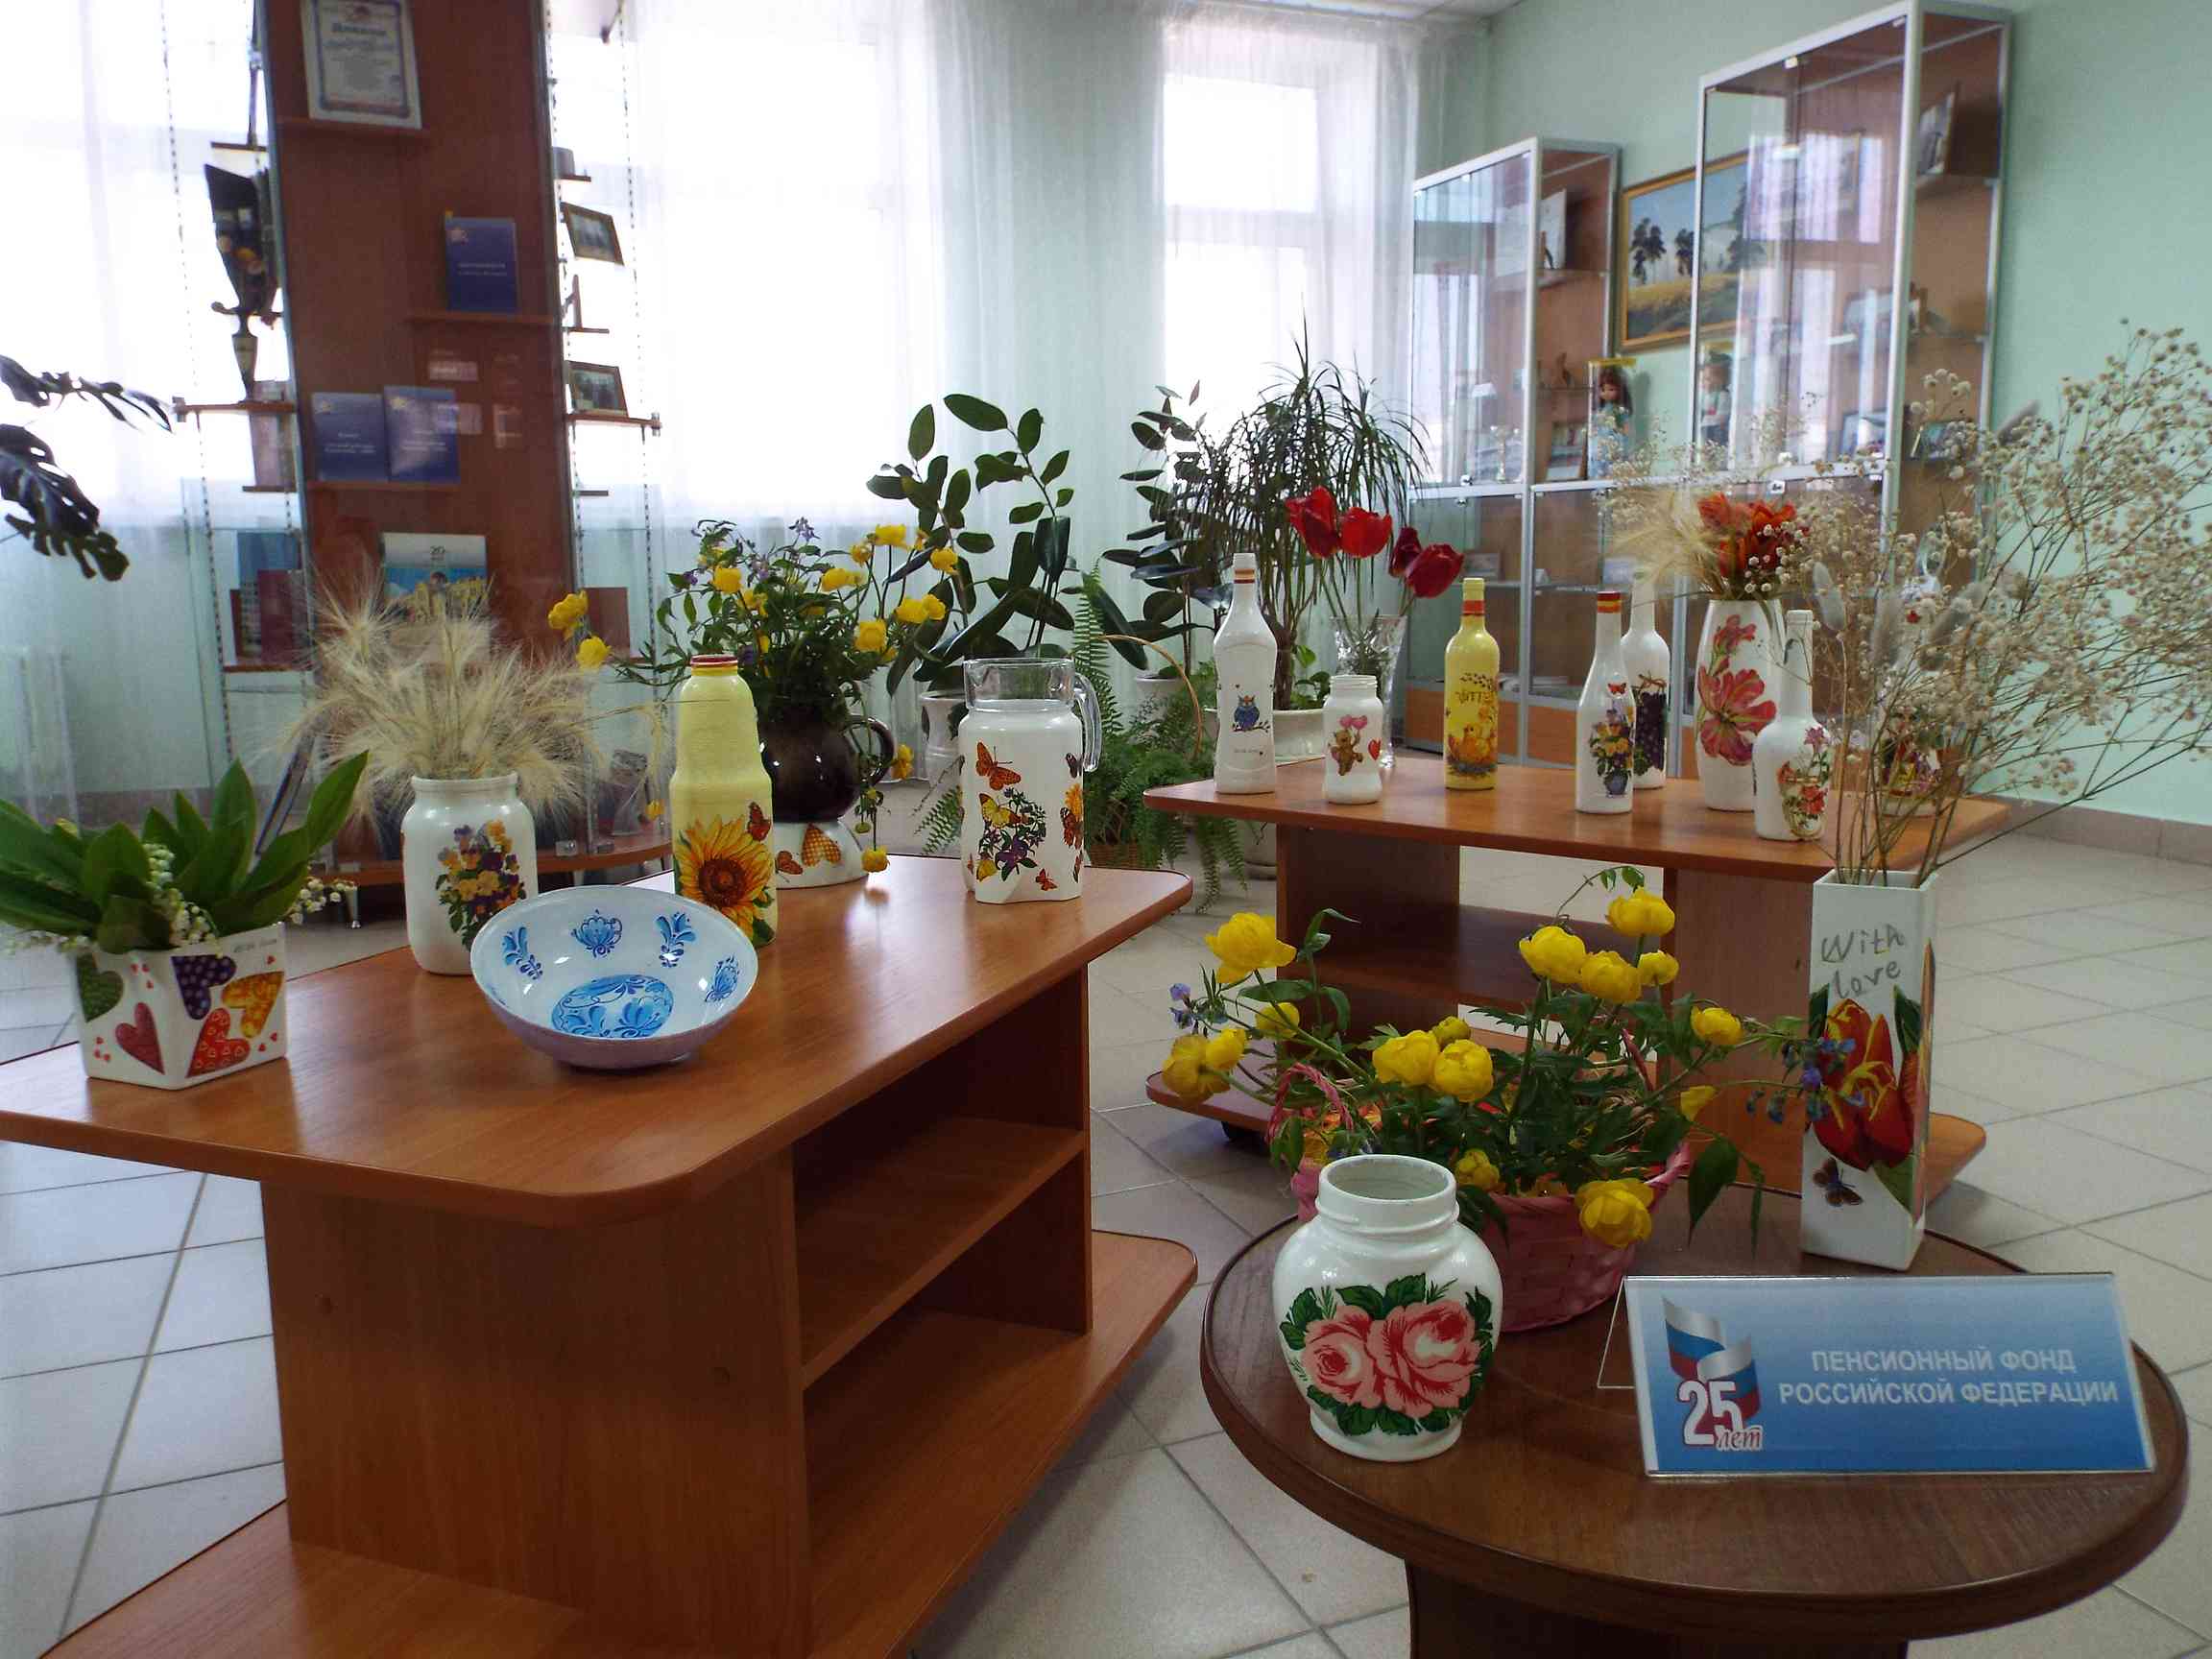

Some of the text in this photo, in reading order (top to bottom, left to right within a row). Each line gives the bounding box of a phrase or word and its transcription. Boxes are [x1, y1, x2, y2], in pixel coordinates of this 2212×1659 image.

[1820, 924, 1905, 964] With
[1833, 960, 1901, 999] love
[1812, 1346, 2077, 1374] ПЕНСИОННЫЙ ФОНД
[1779, 1378, 2119, 1407] РОССИЙСКОЙ ФЕДЕРАЦИИ
[1677, 1380, 1743, 1445] 25
